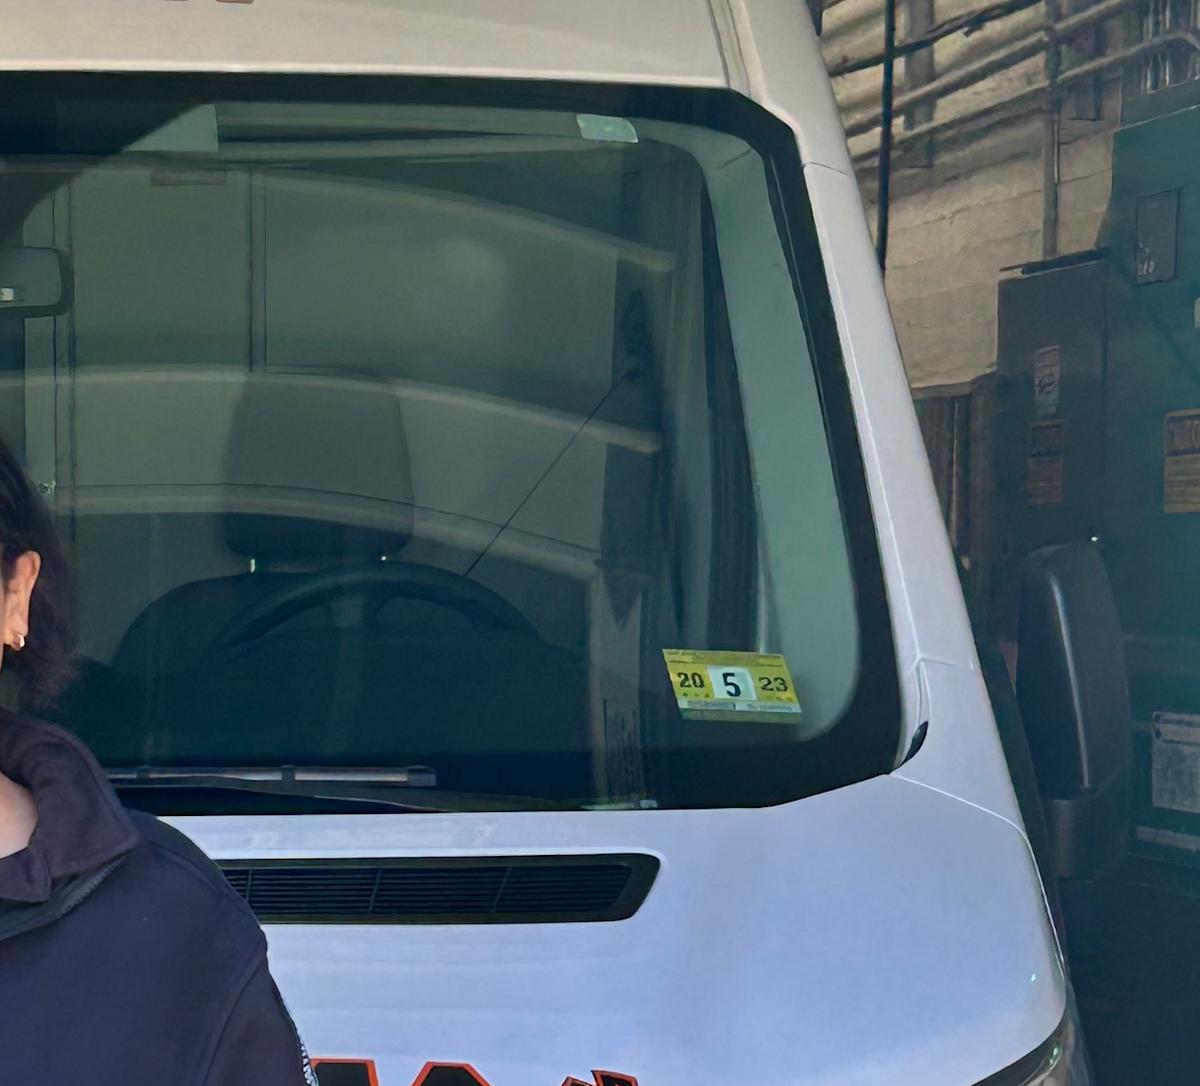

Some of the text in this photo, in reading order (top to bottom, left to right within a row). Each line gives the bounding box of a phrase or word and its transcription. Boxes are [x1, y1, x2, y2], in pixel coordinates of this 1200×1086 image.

[677, 672, 788, 698] 20 5 23
